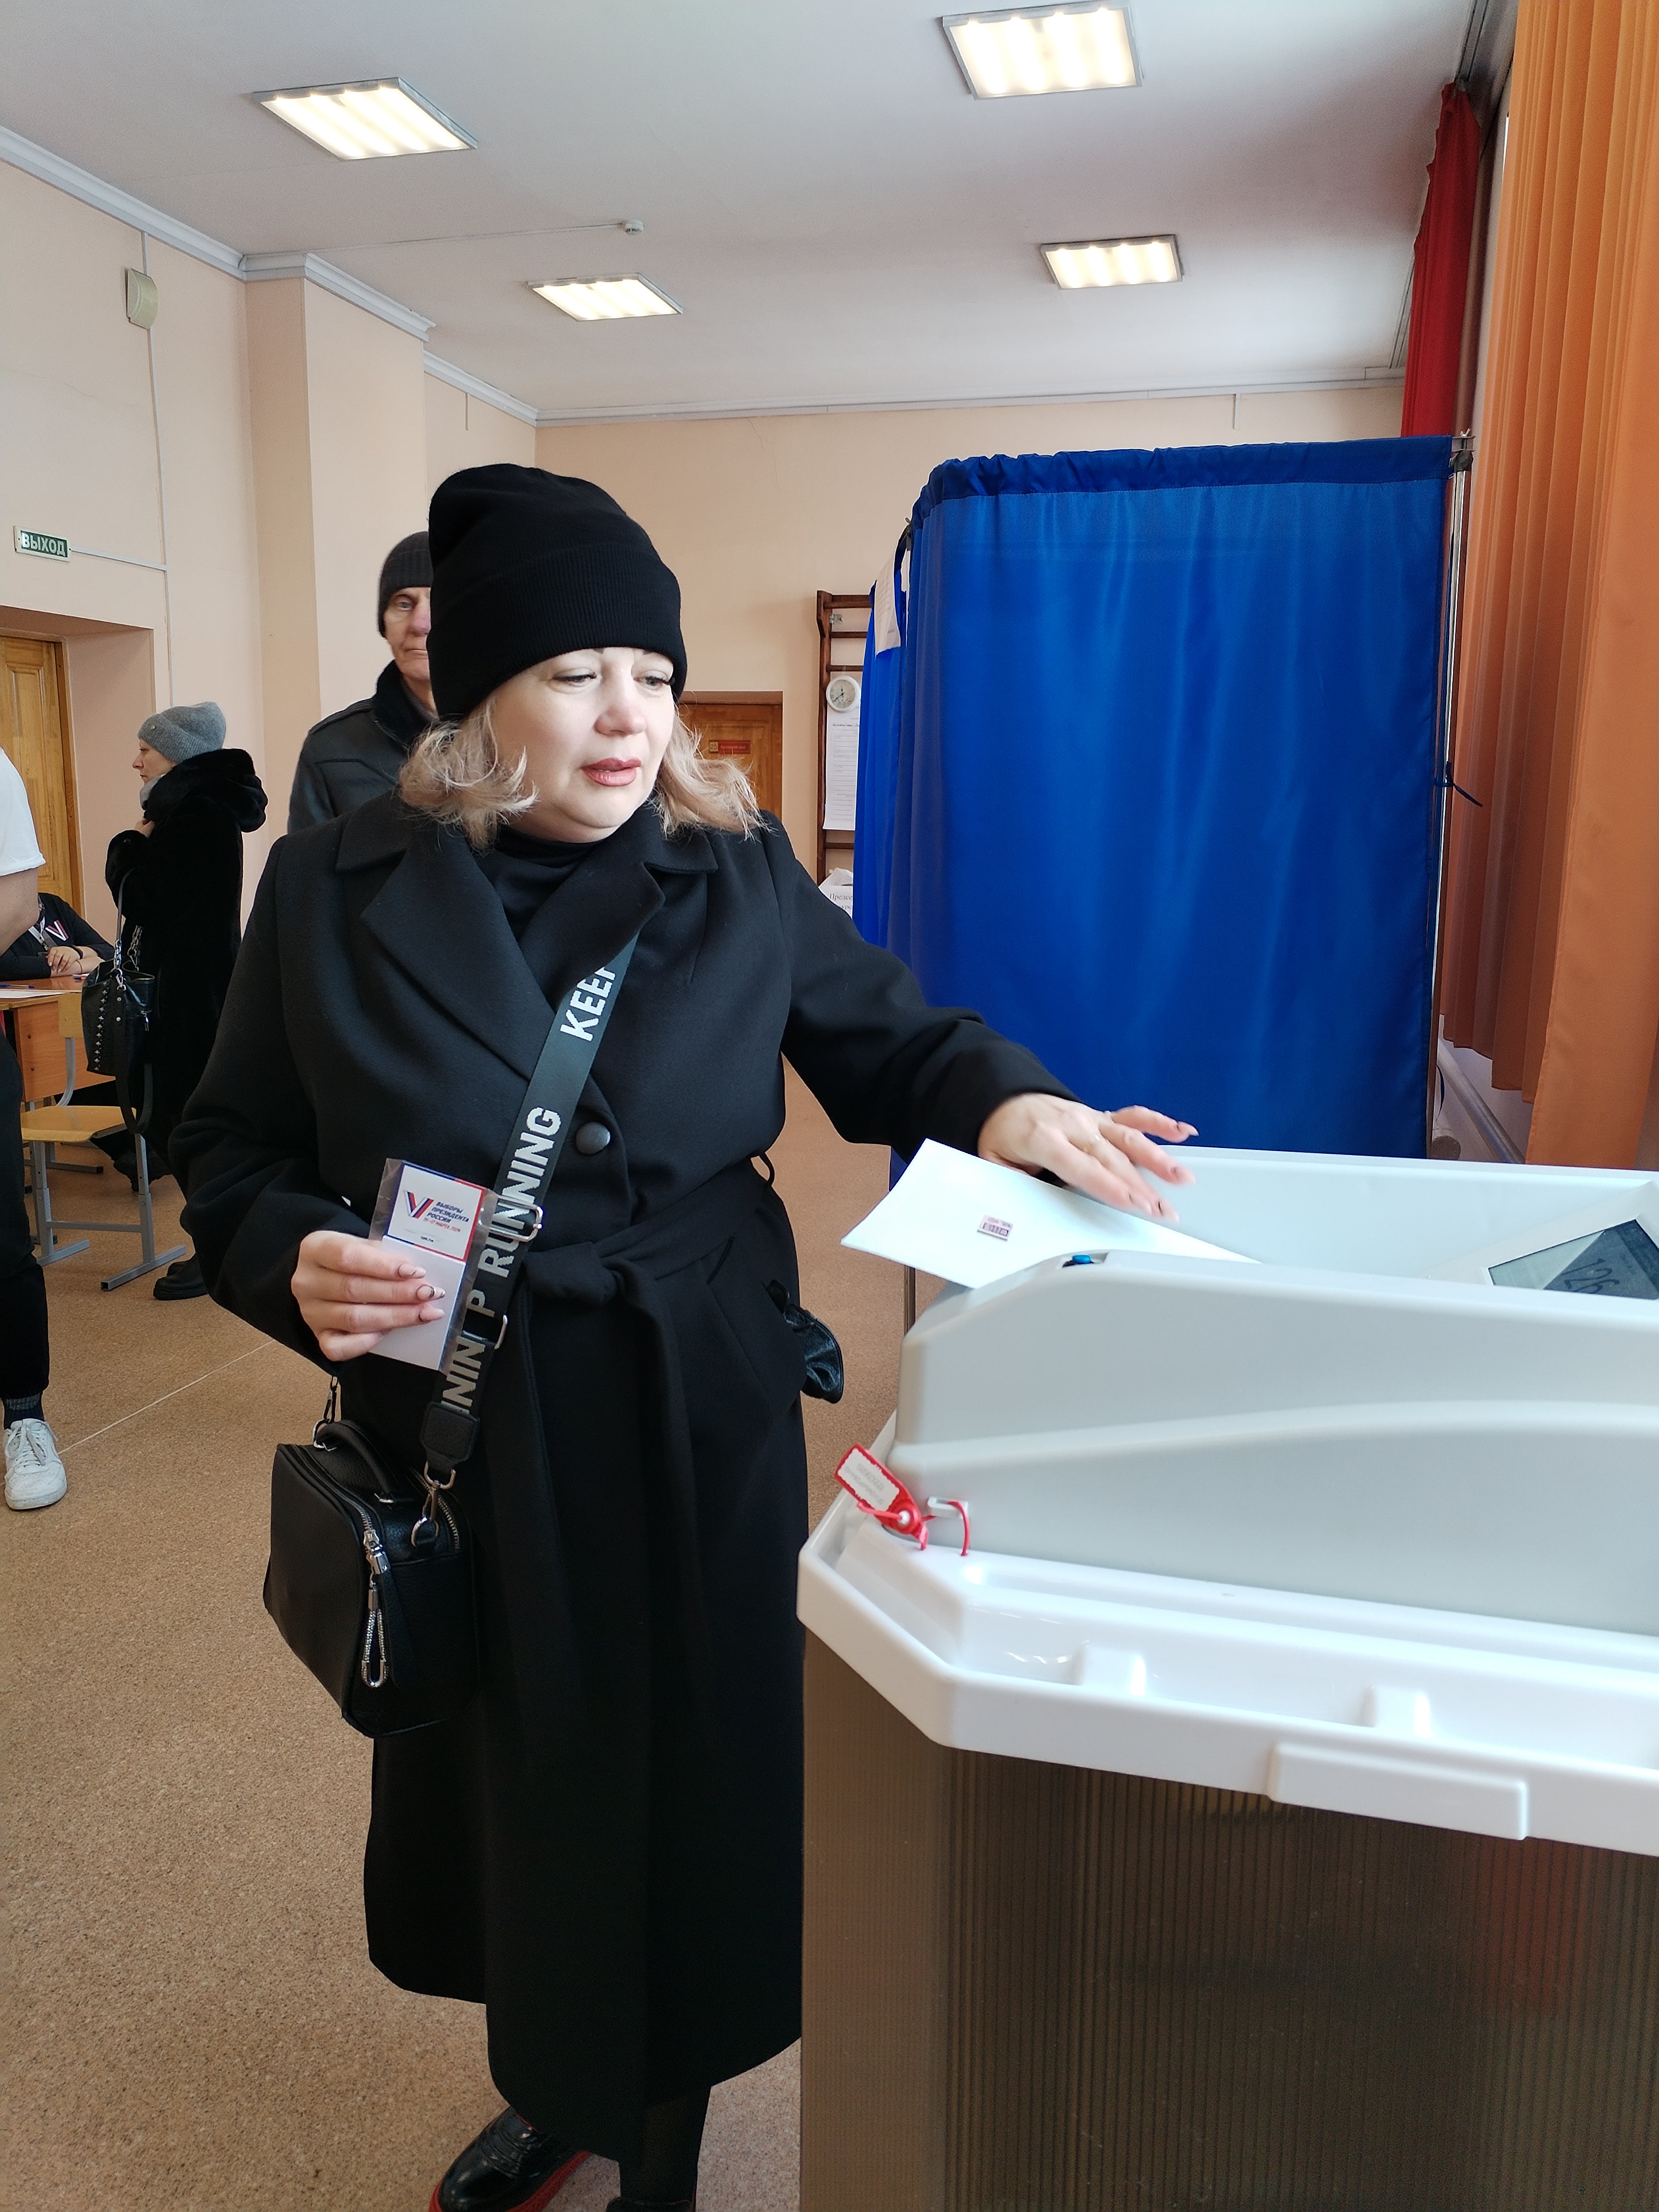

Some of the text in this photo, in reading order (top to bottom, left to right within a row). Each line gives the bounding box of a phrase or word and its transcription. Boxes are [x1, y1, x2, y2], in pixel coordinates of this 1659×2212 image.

[22, 533, 65, 556] ВЫХОД
[478, 1107, 561, 1277] RUNNING
[432, 1207, 469, 1223] ПРЕЗИДЕНТА
[436, 1202, 464, 1214] ВЫБОРЫ
[427, 1213, 452, 1223] РОССИИ
